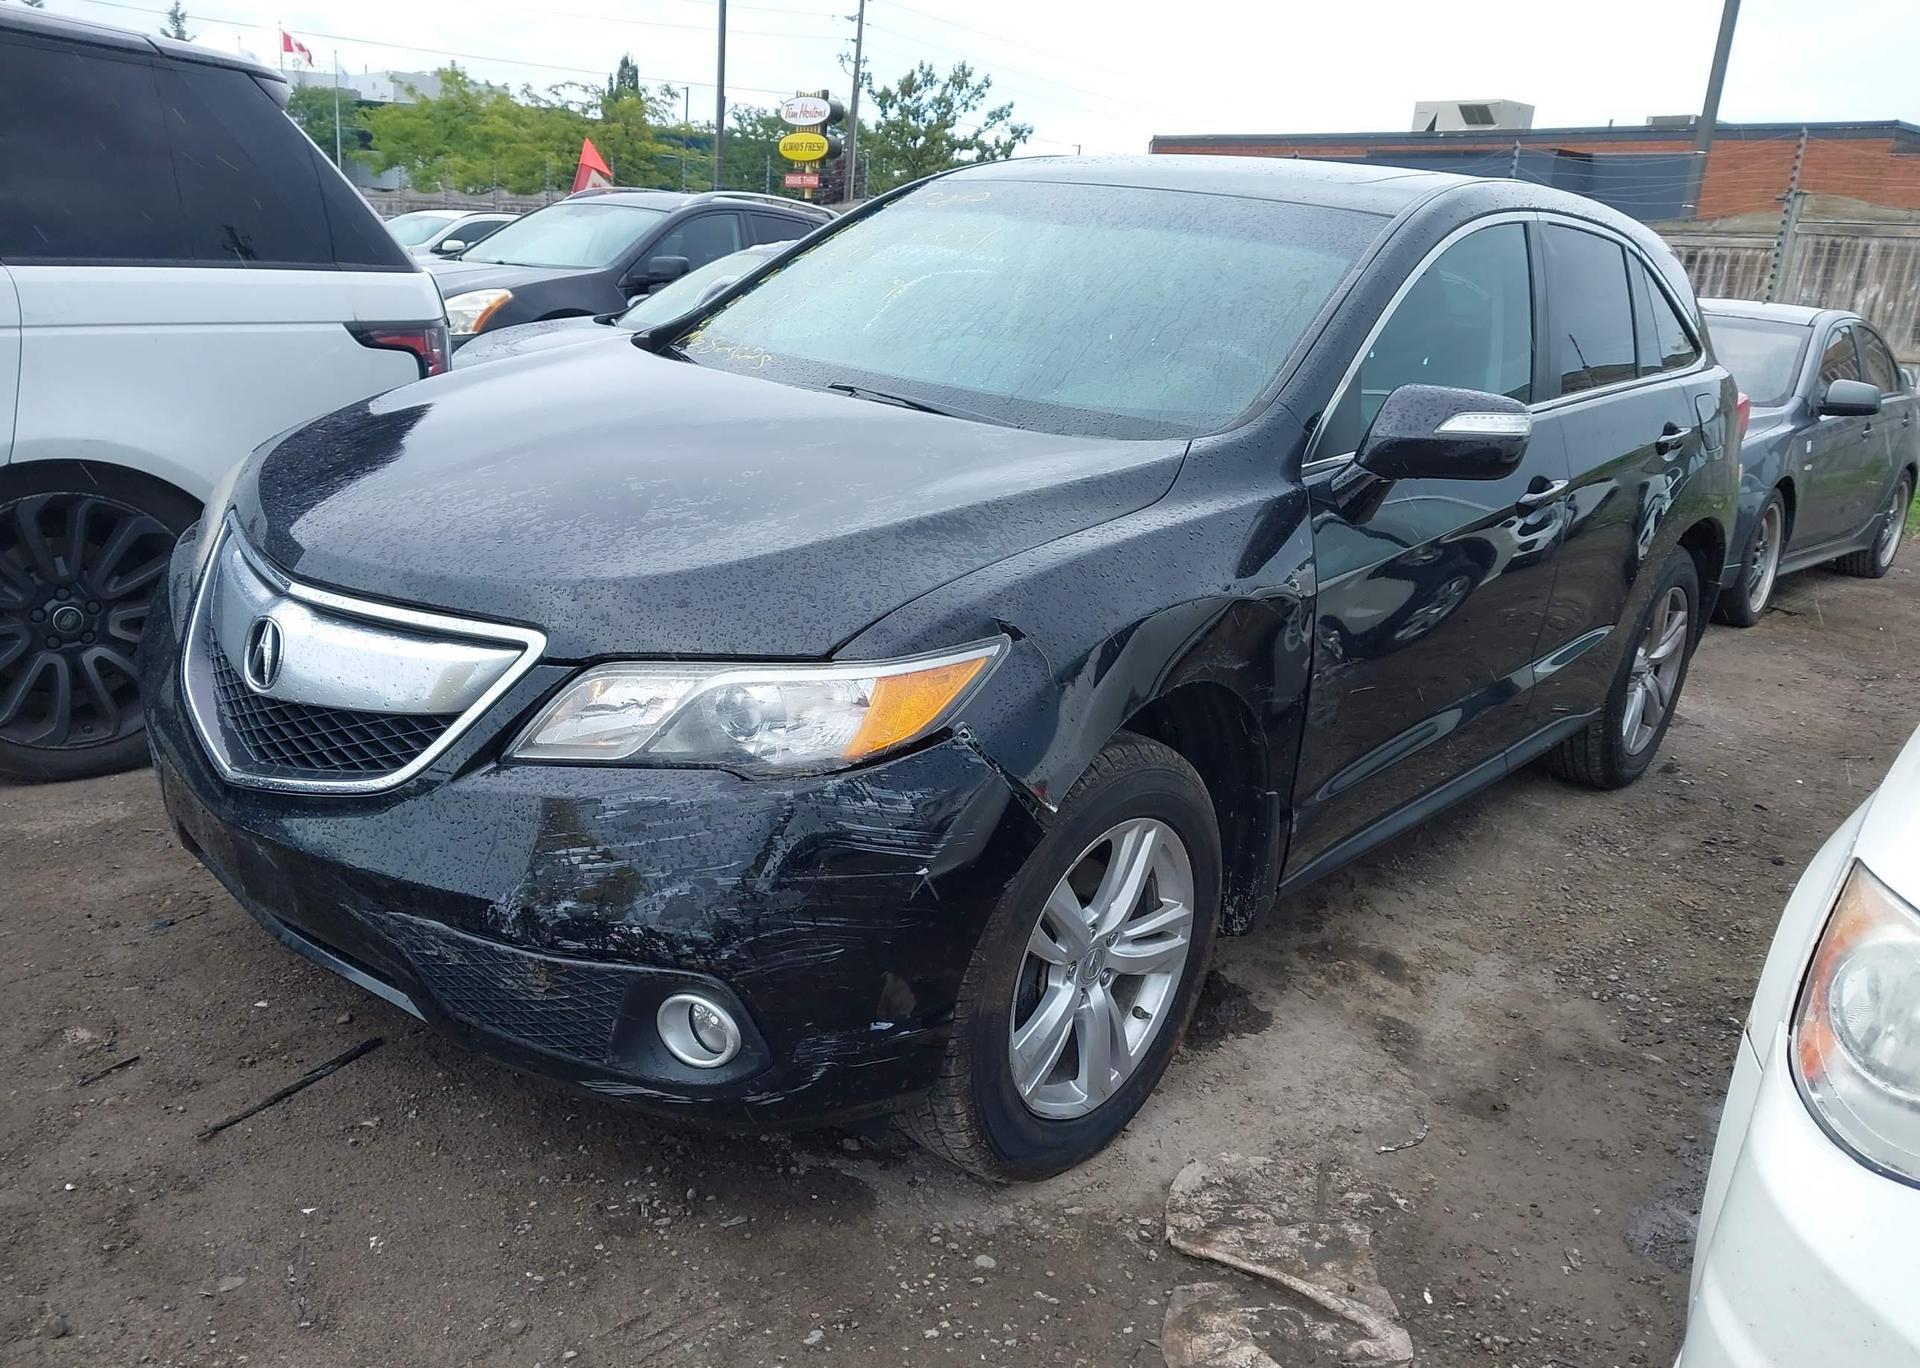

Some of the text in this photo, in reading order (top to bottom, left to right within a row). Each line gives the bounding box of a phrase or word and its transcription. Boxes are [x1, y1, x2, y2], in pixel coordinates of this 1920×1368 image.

[785, 102, 826, 119] Tim Hortons
[783, 142, 825, 152] ALWAYS FRESH
